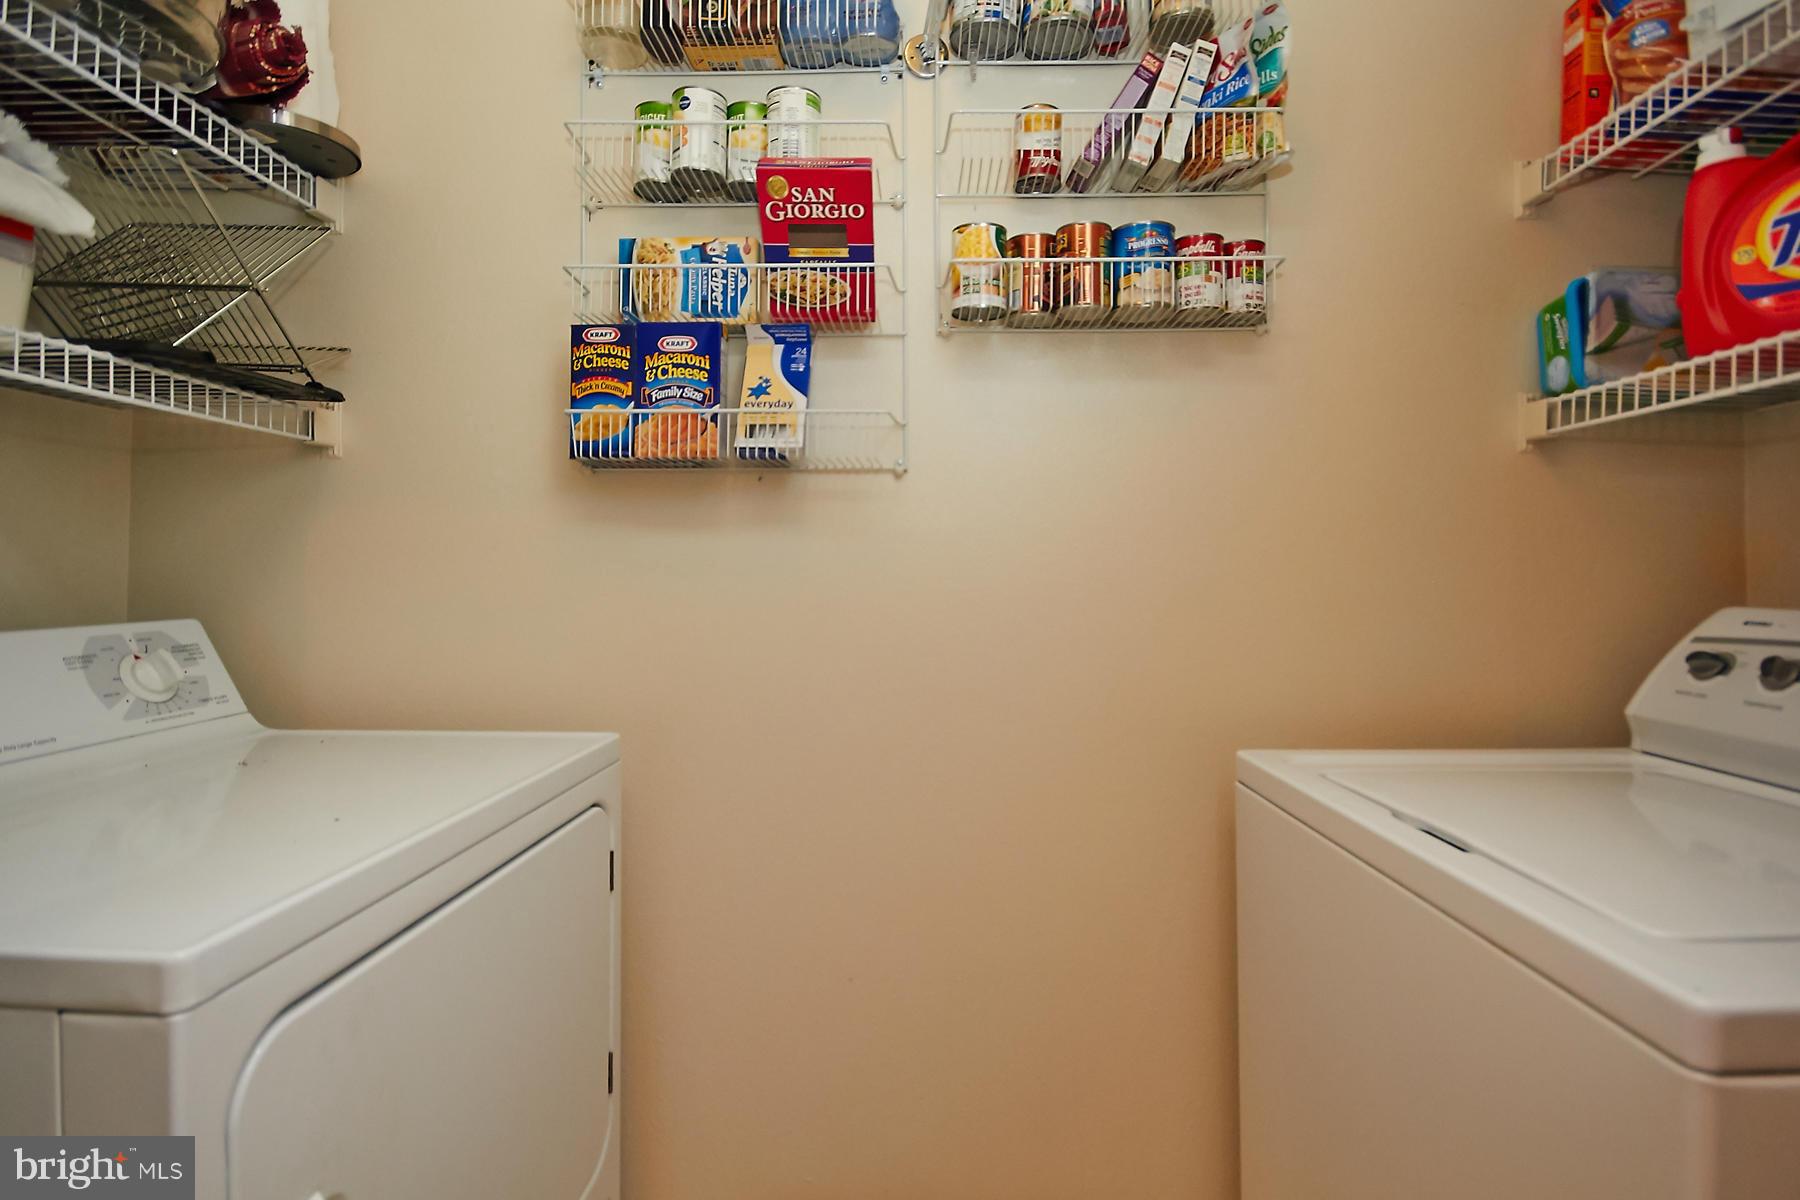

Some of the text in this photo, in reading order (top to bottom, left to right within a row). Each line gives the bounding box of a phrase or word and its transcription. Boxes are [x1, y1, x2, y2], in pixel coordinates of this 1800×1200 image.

[790, 186, 836, 203] SAN
[765, 201, 866, 222] GIORGIO
[1127, 236, 1169, 250] PROGRESSO
[572, 343, 631, 361] Macaroni
[573, 355, 629, 371] & Cheese
[644, 352, 710, 370] Macaroni
[645, 365, 708, 383] & Cheese
[651, 386, 704, 403] Family Size
[744, 400, 793, 409] everyday
